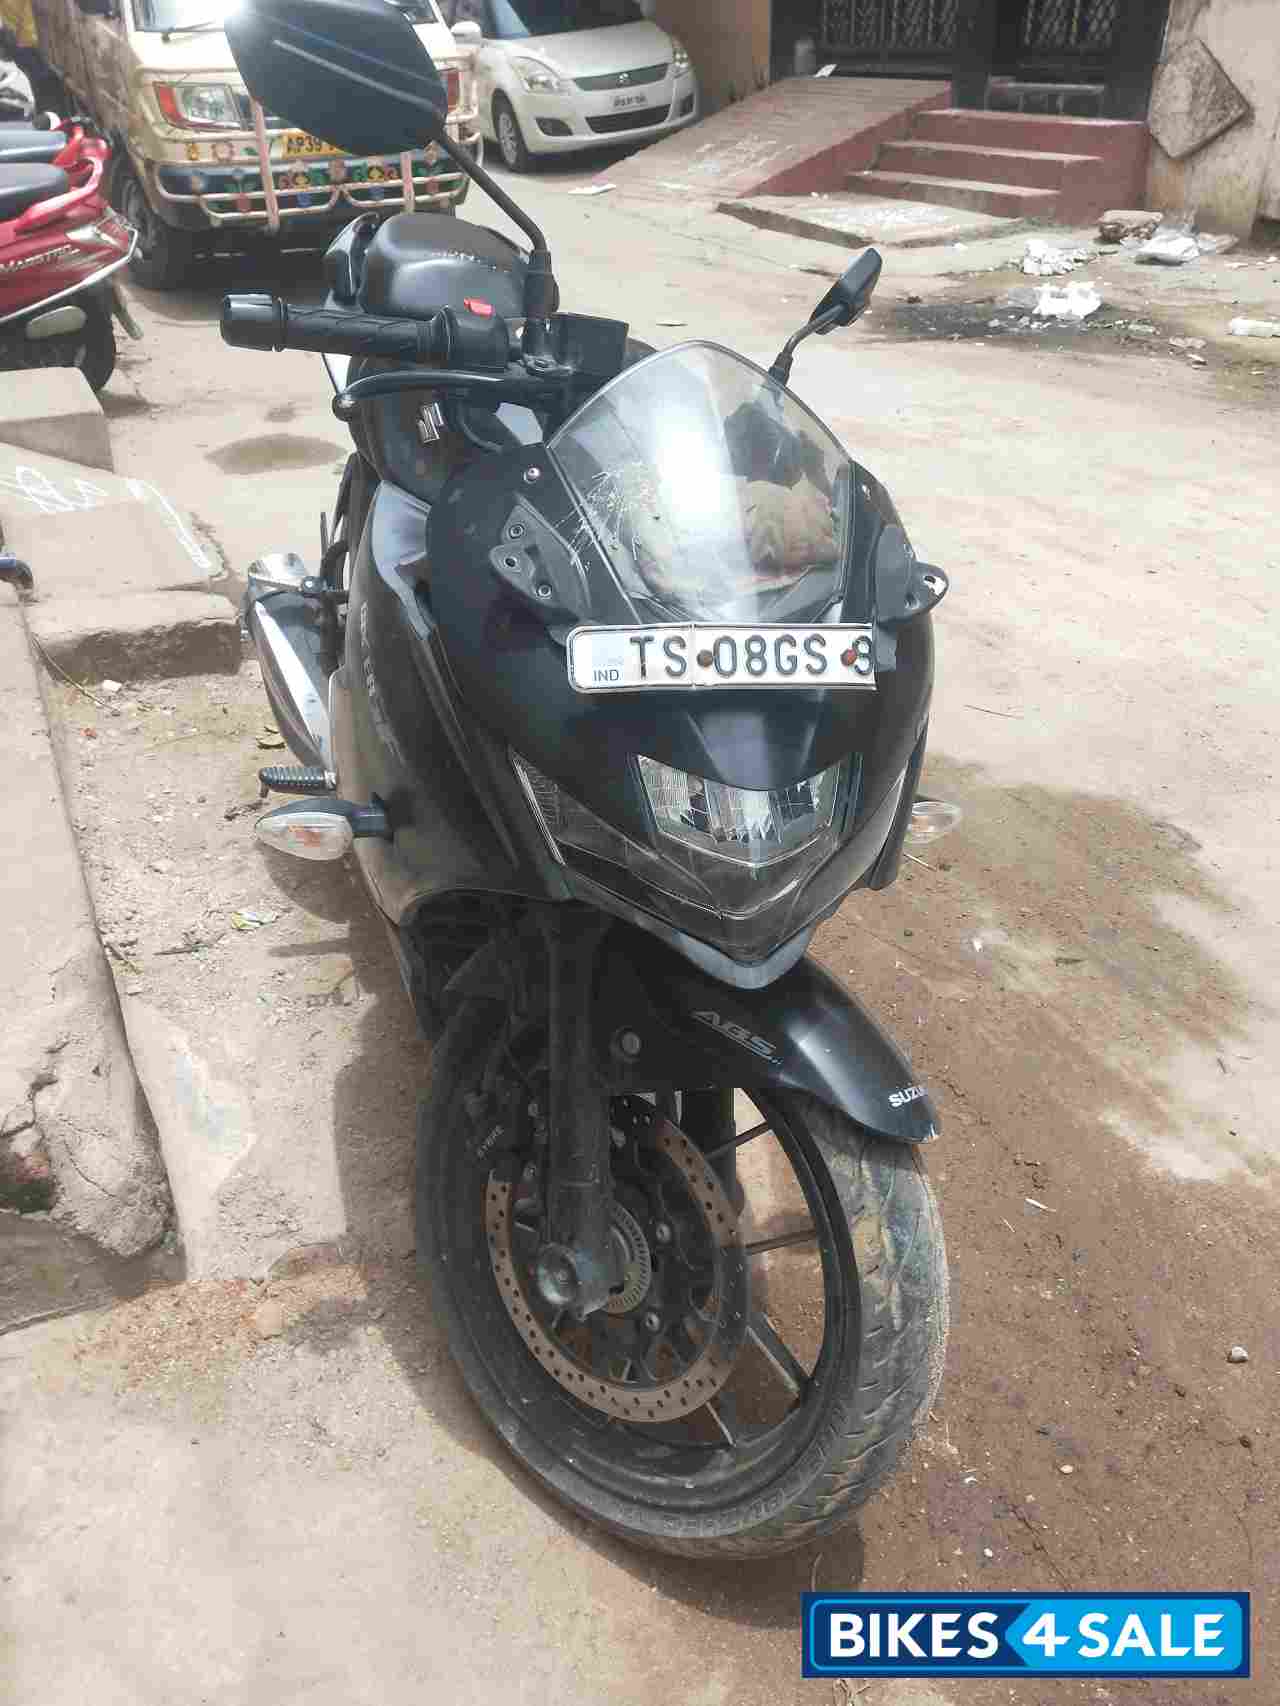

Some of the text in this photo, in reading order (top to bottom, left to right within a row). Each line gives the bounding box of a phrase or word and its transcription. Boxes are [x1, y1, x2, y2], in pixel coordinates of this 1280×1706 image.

[629, 635, 688, 680] TS
[712, 633, 828, 678] 08GS
[593, 669, 620, 682] IND
